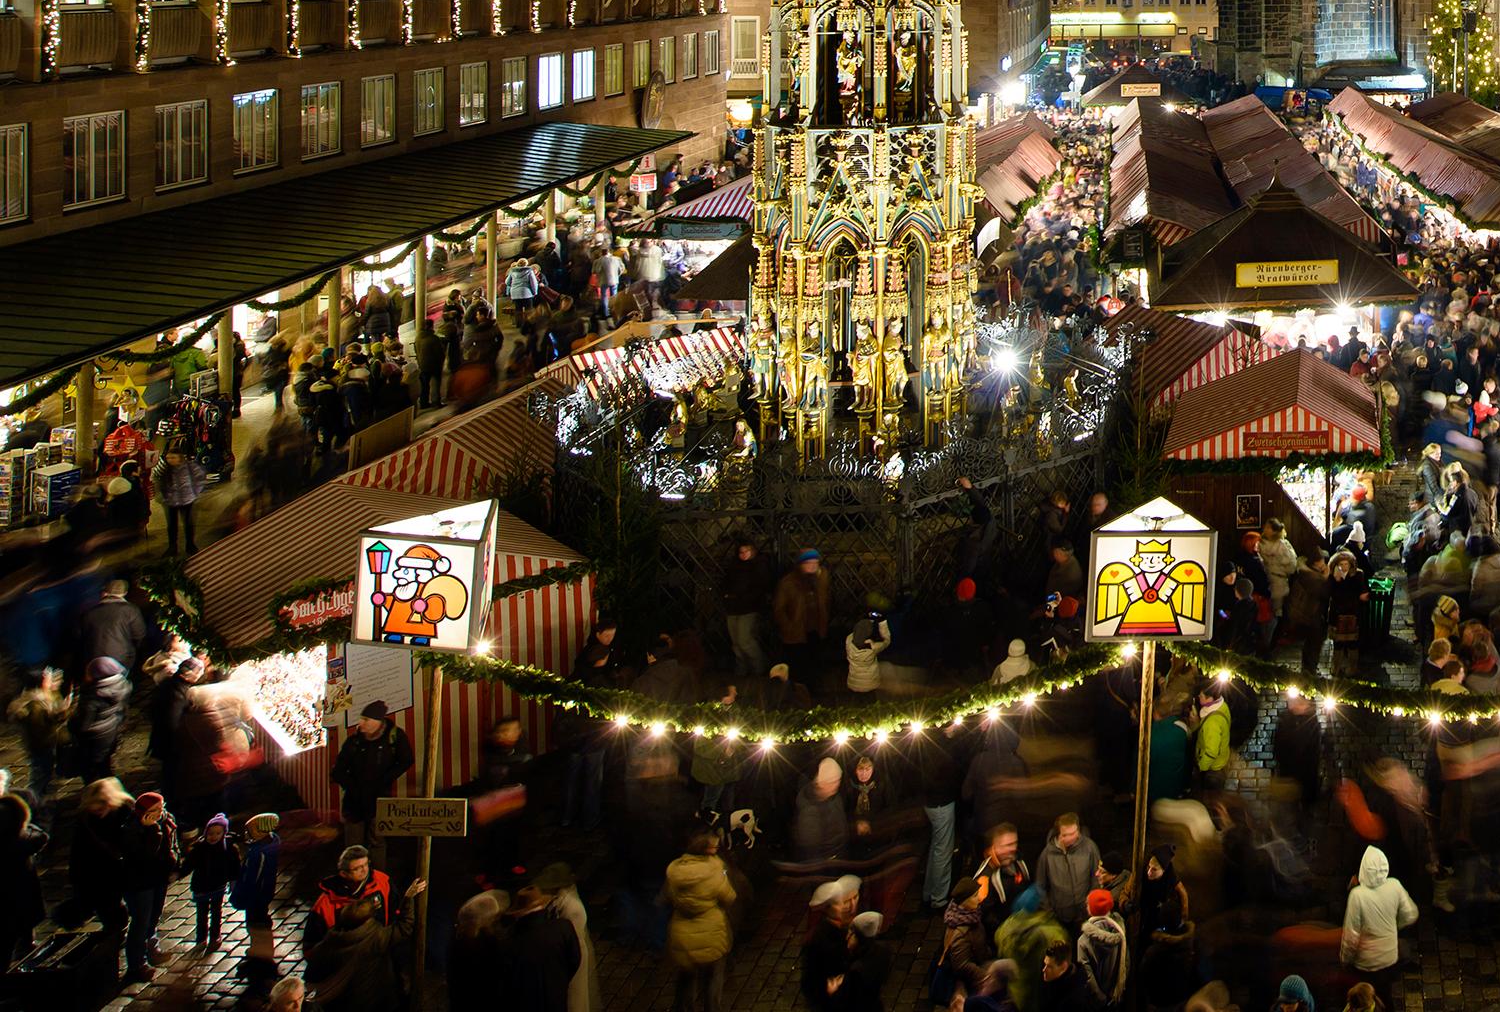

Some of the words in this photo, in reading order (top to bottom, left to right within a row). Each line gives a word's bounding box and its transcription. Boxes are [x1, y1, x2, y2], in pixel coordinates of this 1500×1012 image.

[1256, 264, 1322, 274] Nürnberger-
[1257, 274, 1319, 283] Bratwürste
[387, 803, 457, 818] Postkutsche
